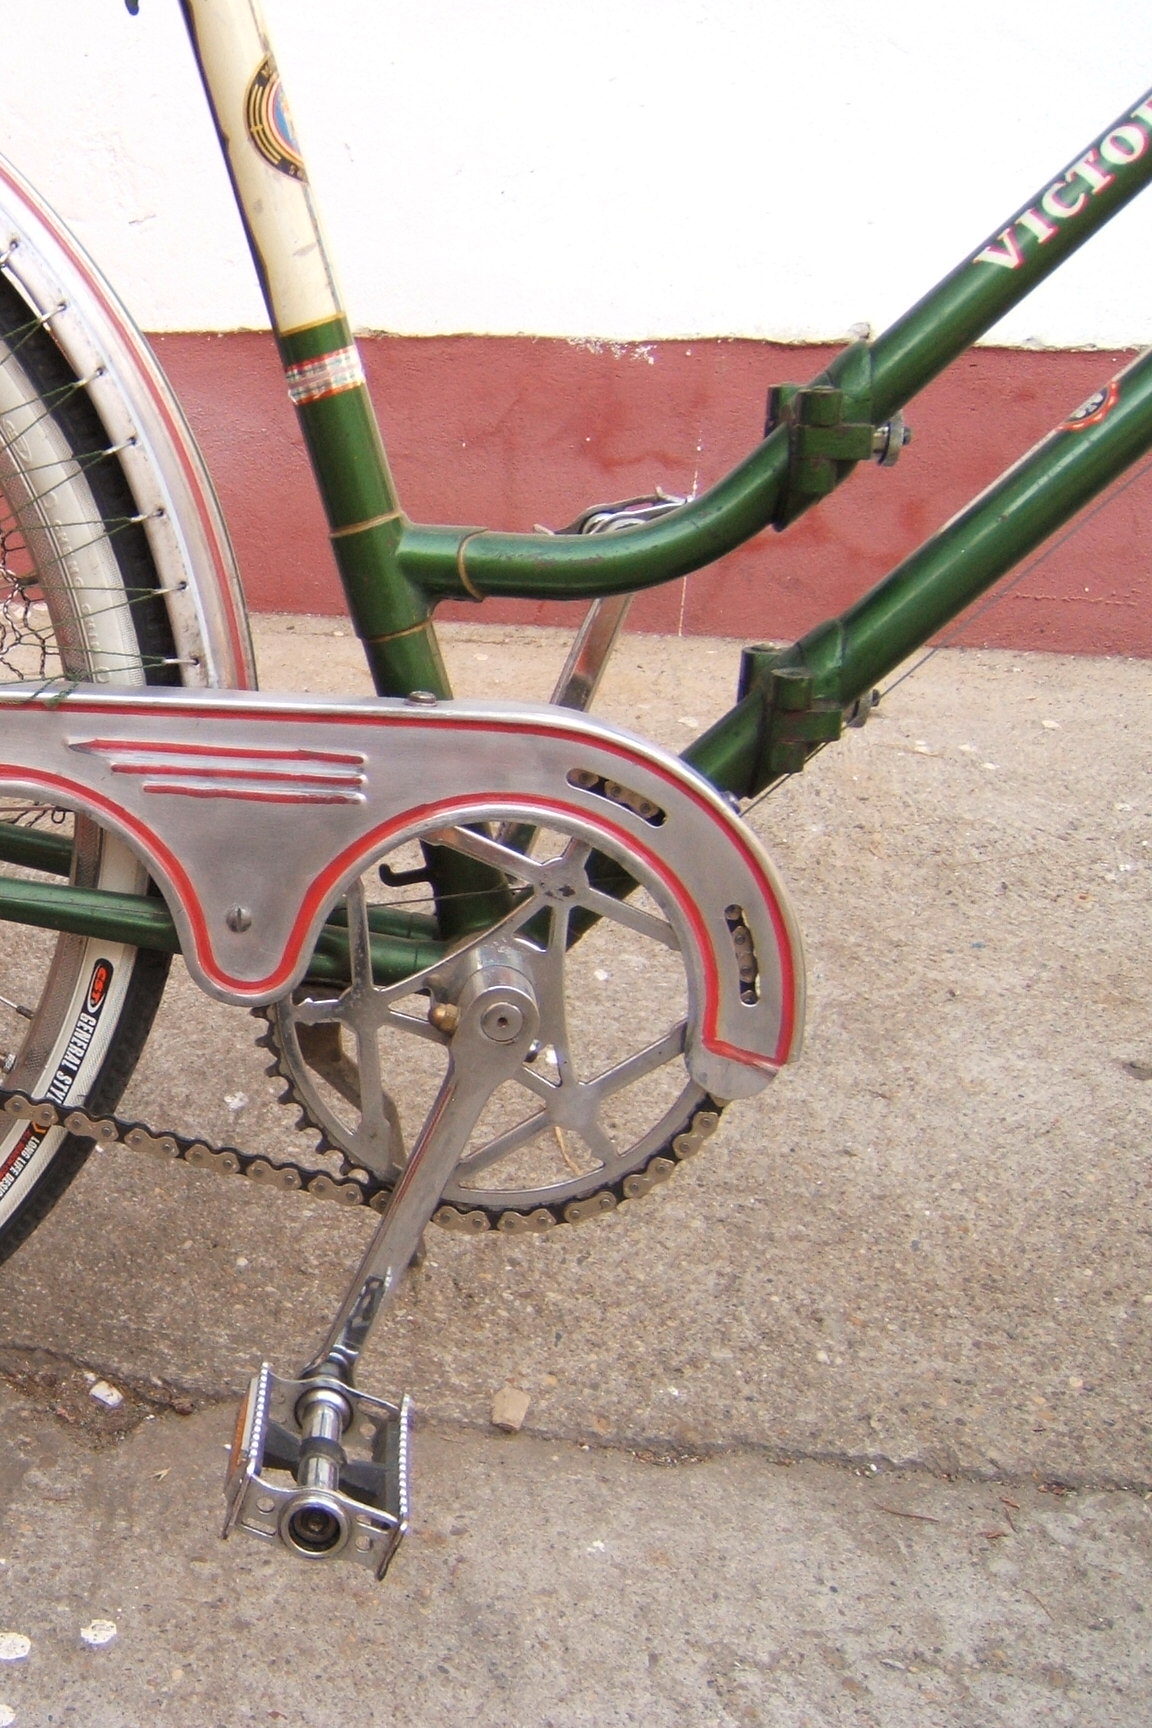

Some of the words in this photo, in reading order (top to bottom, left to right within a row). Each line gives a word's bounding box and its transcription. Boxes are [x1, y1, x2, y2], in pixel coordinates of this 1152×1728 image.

[972, 97, 1152, 269] VICTO
[63, 1011, 98, 1072] GENERAL
[8, 1155, 28, 1177] LIFE
[20, 1134, 41, 1159] LONG
